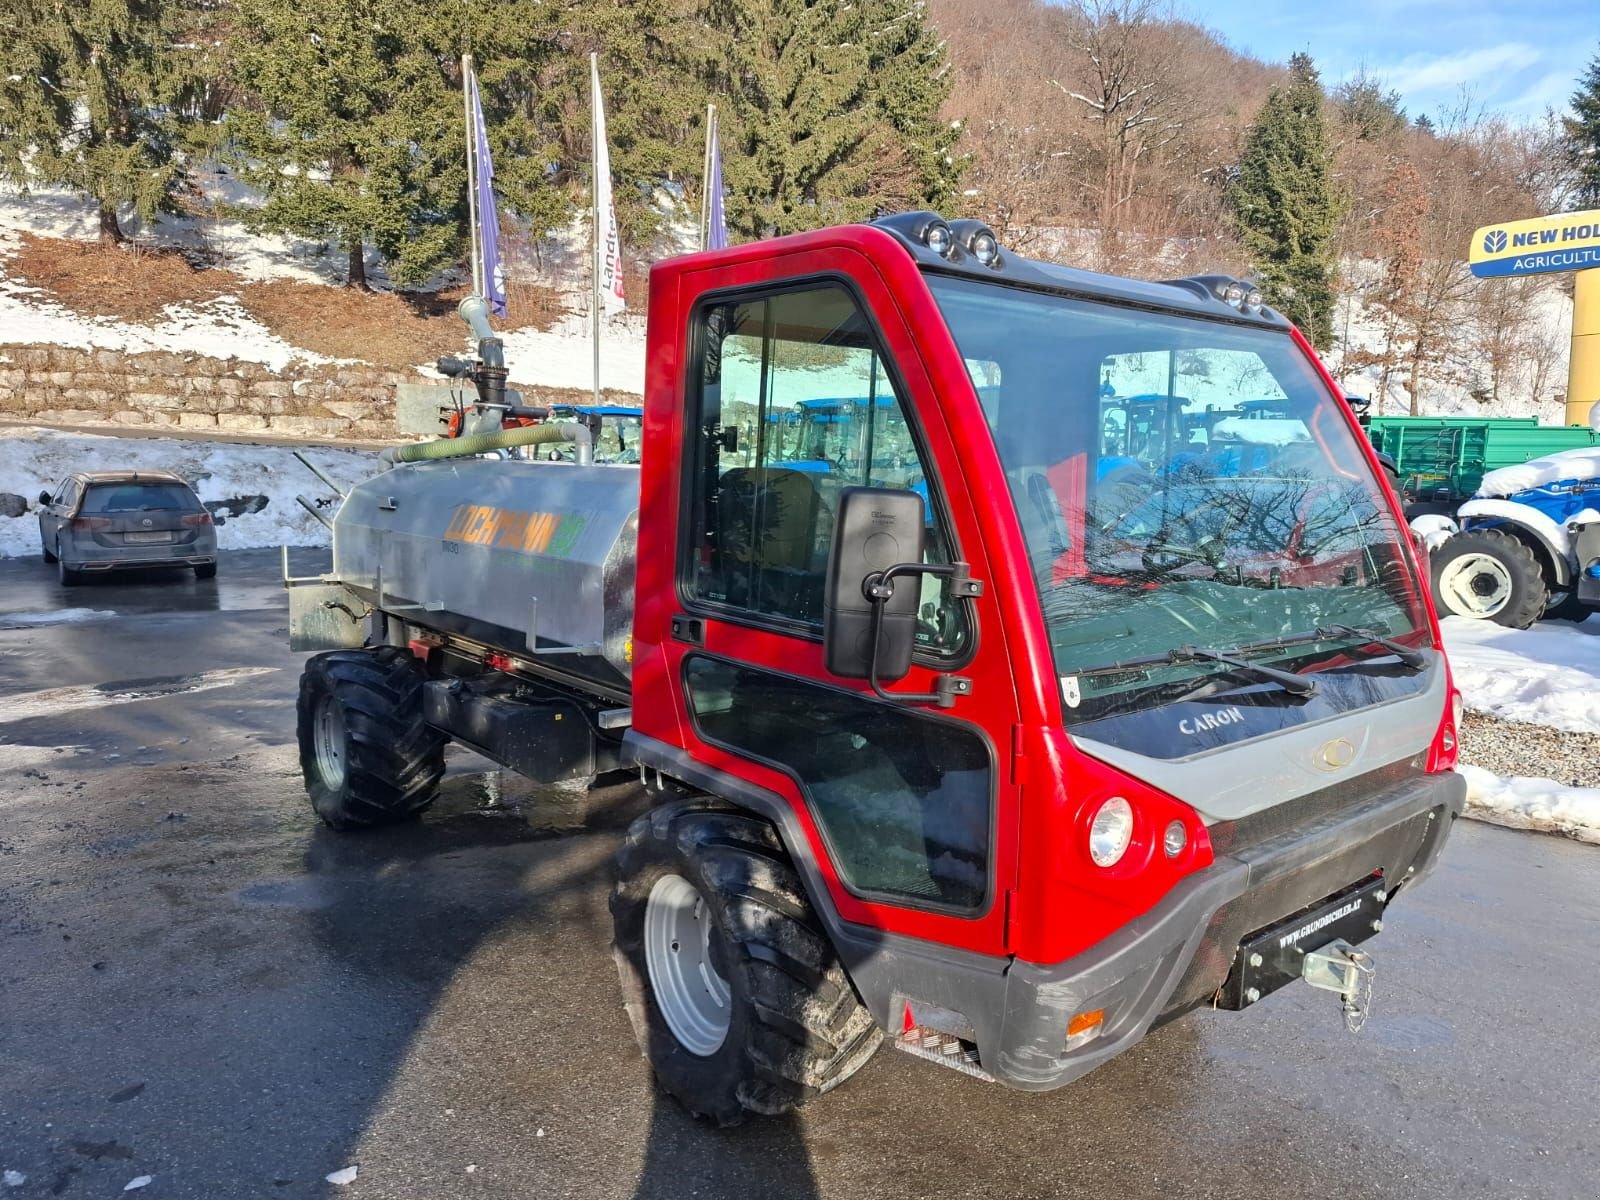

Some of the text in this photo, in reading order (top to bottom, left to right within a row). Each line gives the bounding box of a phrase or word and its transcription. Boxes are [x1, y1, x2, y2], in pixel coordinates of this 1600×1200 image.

[602, 201, 617, 290] Landtec
[1512, 223, 1600, 247] NEW HOL
[1513, 249, 1600, 270] AGRICULTU
[444, 504, 562, 555] LOCHMANN
[1178, 707, 1245, 735] CARON
[1280, 898, 1362, 949] WWW.GRUNDBICHLER.AT
